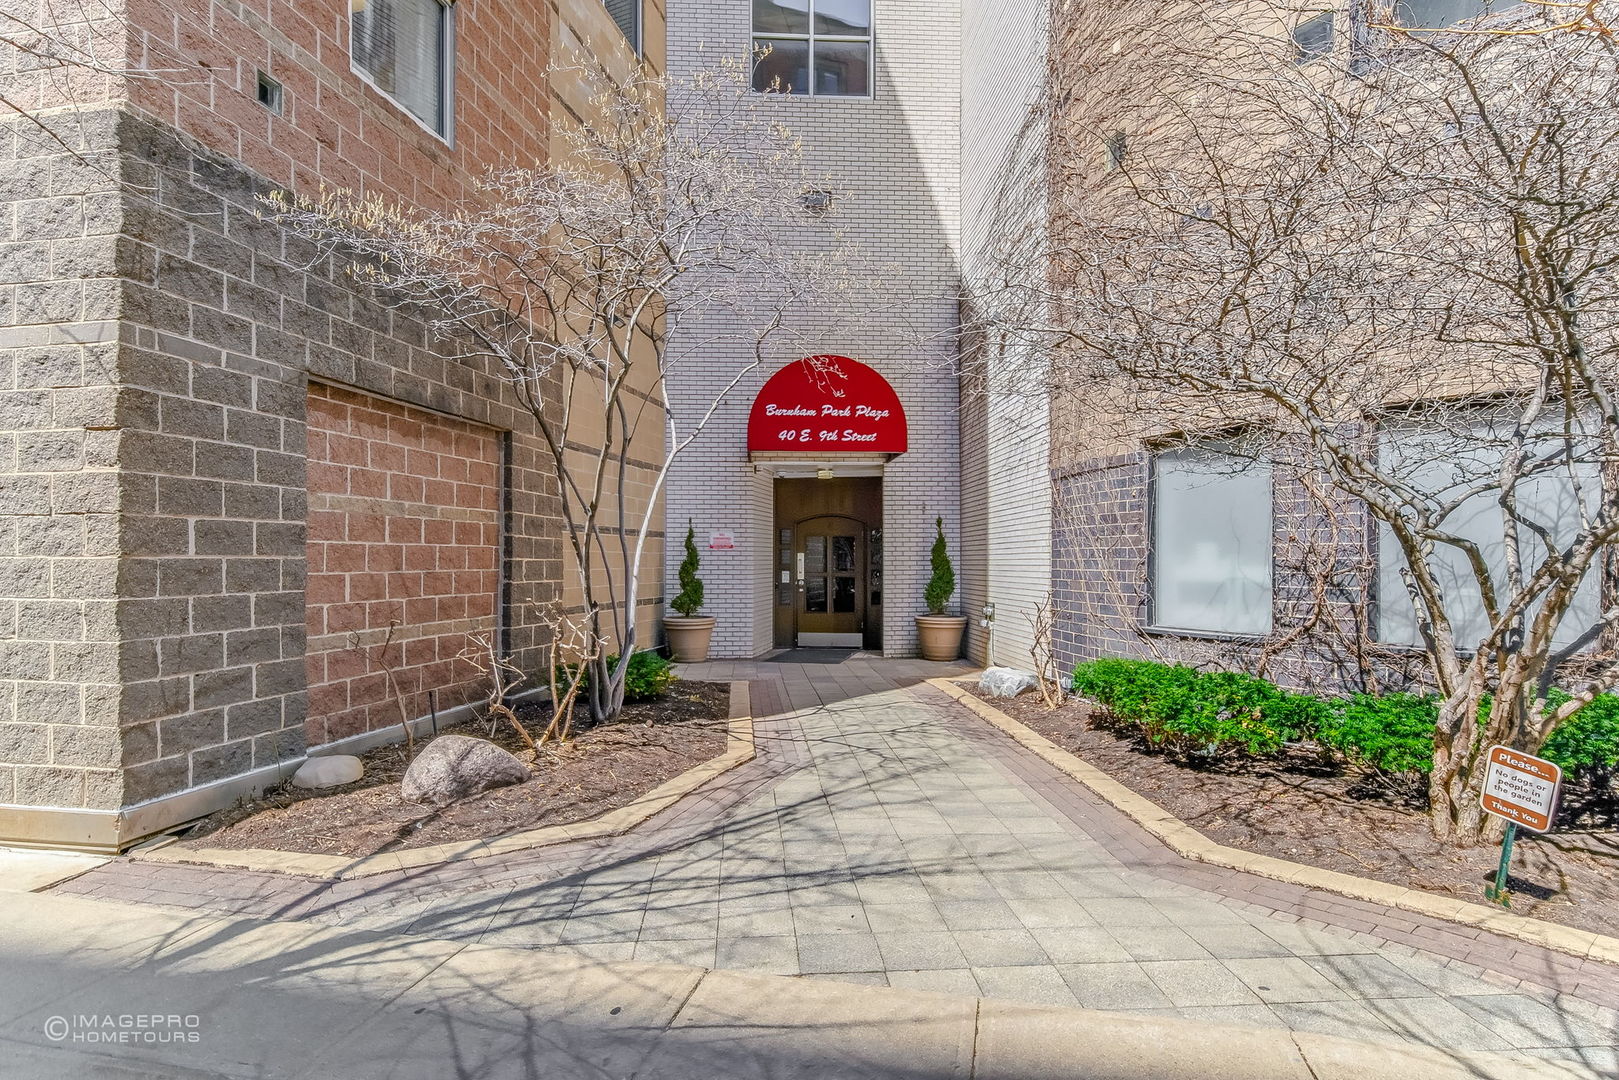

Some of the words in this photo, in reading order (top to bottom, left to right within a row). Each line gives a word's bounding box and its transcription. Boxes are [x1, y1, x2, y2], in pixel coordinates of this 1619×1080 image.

[765, 403, 817, 417] Burnham
[821, 404, 850, 417] Park
[855, 404, 890, 421] Plaza
[778, 429, 796, 441] 40
[799, 429, 812, 442] E.
[818, 430, 838, 441] 9th
[841, 429, 877, 442] Street
[1499, 753, 1551, 778] Please...
[1495, 769, 1508, 778] No
[1511, 775, 1533, 787] dogs
[1494, 784, 1508, 794] the
[1511, 791, 1543, 807] garden
[1497, 779, 1529, 793] people
[1531, 789, 1541, 798] in
[1491, 800, 1519, 817] Thank
[1521, 812, 1538, 824] You
